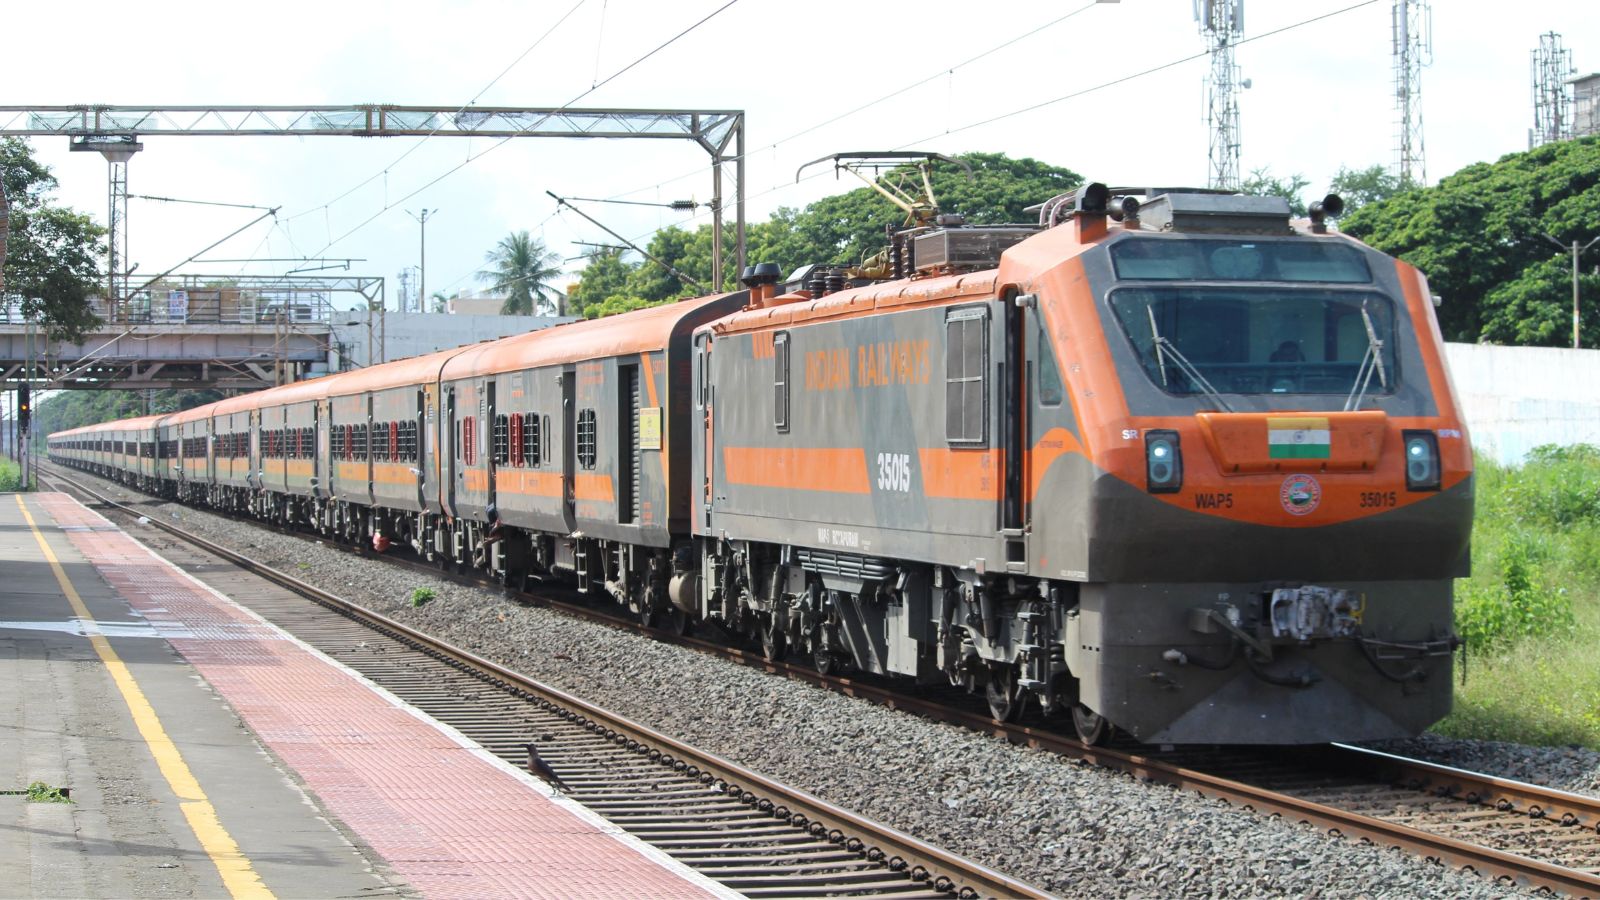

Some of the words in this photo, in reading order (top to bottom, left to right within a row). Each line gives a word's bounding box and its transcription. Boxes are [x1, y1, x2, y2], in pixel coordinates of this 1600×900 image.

[805, 349, 850, 390] INDIAN
[858, 340, 930, 387] RAILWAYS
[1121, 429, 1138, 440] SR
[877, 452, 911, 493] 35015
[1195, 492, 1234, 509] WAP5
[1359, 491, 1397, 508] 35015
